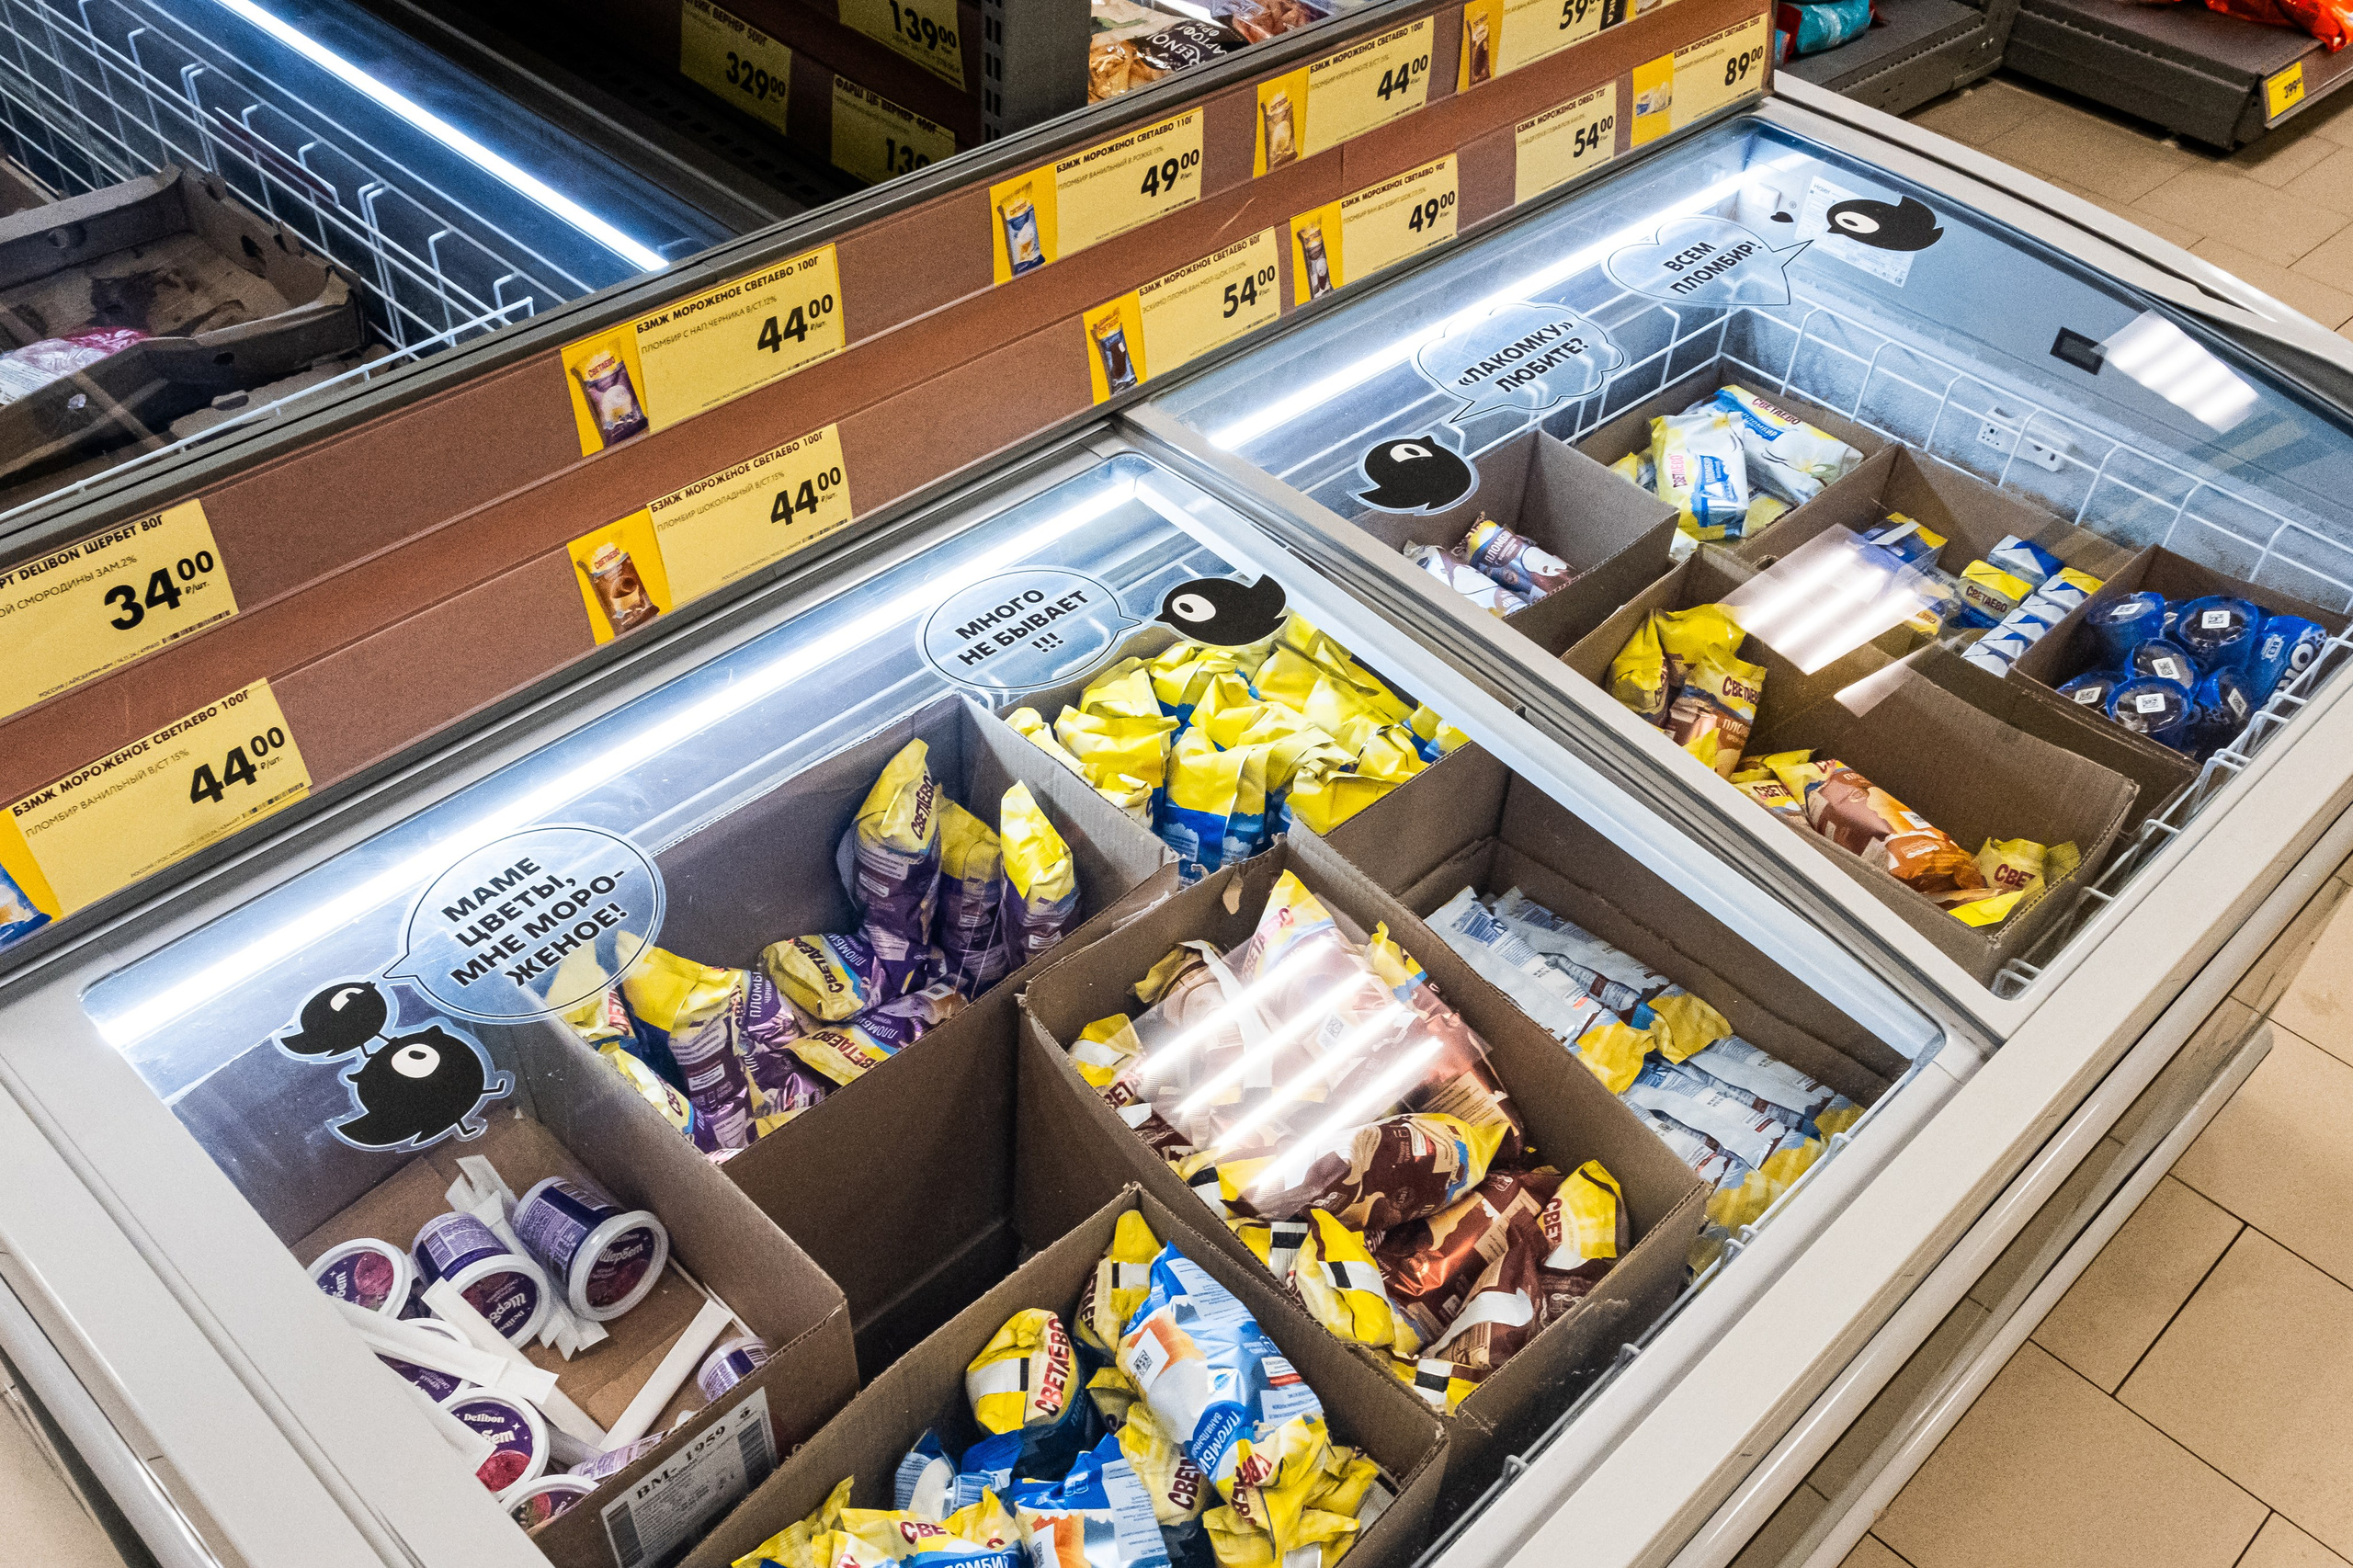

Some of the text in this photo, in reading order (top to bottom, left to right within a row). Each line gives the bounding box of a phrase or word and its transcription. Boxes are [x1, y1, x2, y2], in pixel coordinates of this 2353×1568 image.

[938, 26, 957, 48] 00
[726, 51, 785, 100] 329 00
[1377, 62, 1410, 101] 44
[1412, 55, 1428, 74] 00
[1724, 52, 1750, 86] 89
[1751, 45, 1763, 62] 00
[1056, 157, 1081, 174] БЗМЖ
[1083, 137, 1135, 163] МОРОЖЕНОЕ
[1137, 122, 1174, 142] СВЕТАЕВО
[1574, 122, 1599, 158] 54
[1600, 115, 1613, 132] 00
[1141, 148, 1199, 198] 49 00
[1408, 199, 1438, 233] 49
[1440, 190, 1455, 210] 00
[1139, 281, 1162, 296] БЗМЖ
[1164, 259, 1211, 286] МОРОЖЕНОЕ
[1213, 241, 1247, 263] СВЕТАЕВО
[1663, 241, 1717, 273] ВСЕМ
[1669, 241, 1764, 295] ПЛОМБИР!
[636, 256, 819, 335] БЗМЖ МОРОЖЕНОЕ СВЕТАЕВО 100Г
[1223, 275, 1257, 319] 54
[1257, 266, 1276, 286] 00
[642, 333, 683, 355] ПЛОМБИР
[757, 294, 834, 354] 44 00
[1458, 322, 1574, 387] «ЛАКОМКУ»
[1495, 337, 1590, 392] ЛЮБИТЕ?
[1752, 397, 1802, 426] СВЕТАЕВО
[651, 431, 824, 513] БЗМЖ МОРОЖЕНОЕ СВЕТАЕВО 100Г
[770, 467, 842, 526] 44 00
[657, 511, 696, 532] ПЛОМБИР
[697, 483, 754, 516] ШОКОЛАДНЫЙ
[19, 549, 80, 581] DELIBON
[84, 526, 137, 554] ШЕРБЕТ
[141, 515, 163, 532] 80Г
[17, 572, 95, 609] СМОРОДИНЫ
[104, 551, 214, 631] 34 00
[955, 590, 1045, 640] МНОГО
[1966, 585, 2007, 613] СВЕТАЕВО
[957, 590, 1088, 665] НЕ БЫВАЕТ
[1031, 632, 1064, 653] !!!
[12, 689, 250, 818] БЗМЖ МОРОЖЕНОЕ СВЕТАЕВО 100Г
[189, 727, 285, 805] 44 00
[25, 805, 78, 838] ПЛОМБИР
[80, 768, 147, 810] ВАНИЛЬНЫЙ
[910, 775, 934, 841] СВЕТАЕВО
[441, 857, 542, 923] МАМЕ
[455, 875, 576, 949] ЦВЕТЫ,
[449, 869, 626, 987] МНЕ МОРО-
[505, 902, 629, 988] ЖЕНОЕ!
[827, 933, 867, 967] ПЛОМБИ
[811, 1031, 879, 1070] ВЕТАЕВО
[498, 1312, 525, 1332] Delibo
[464, 1414, 505, 1424] Delibon
